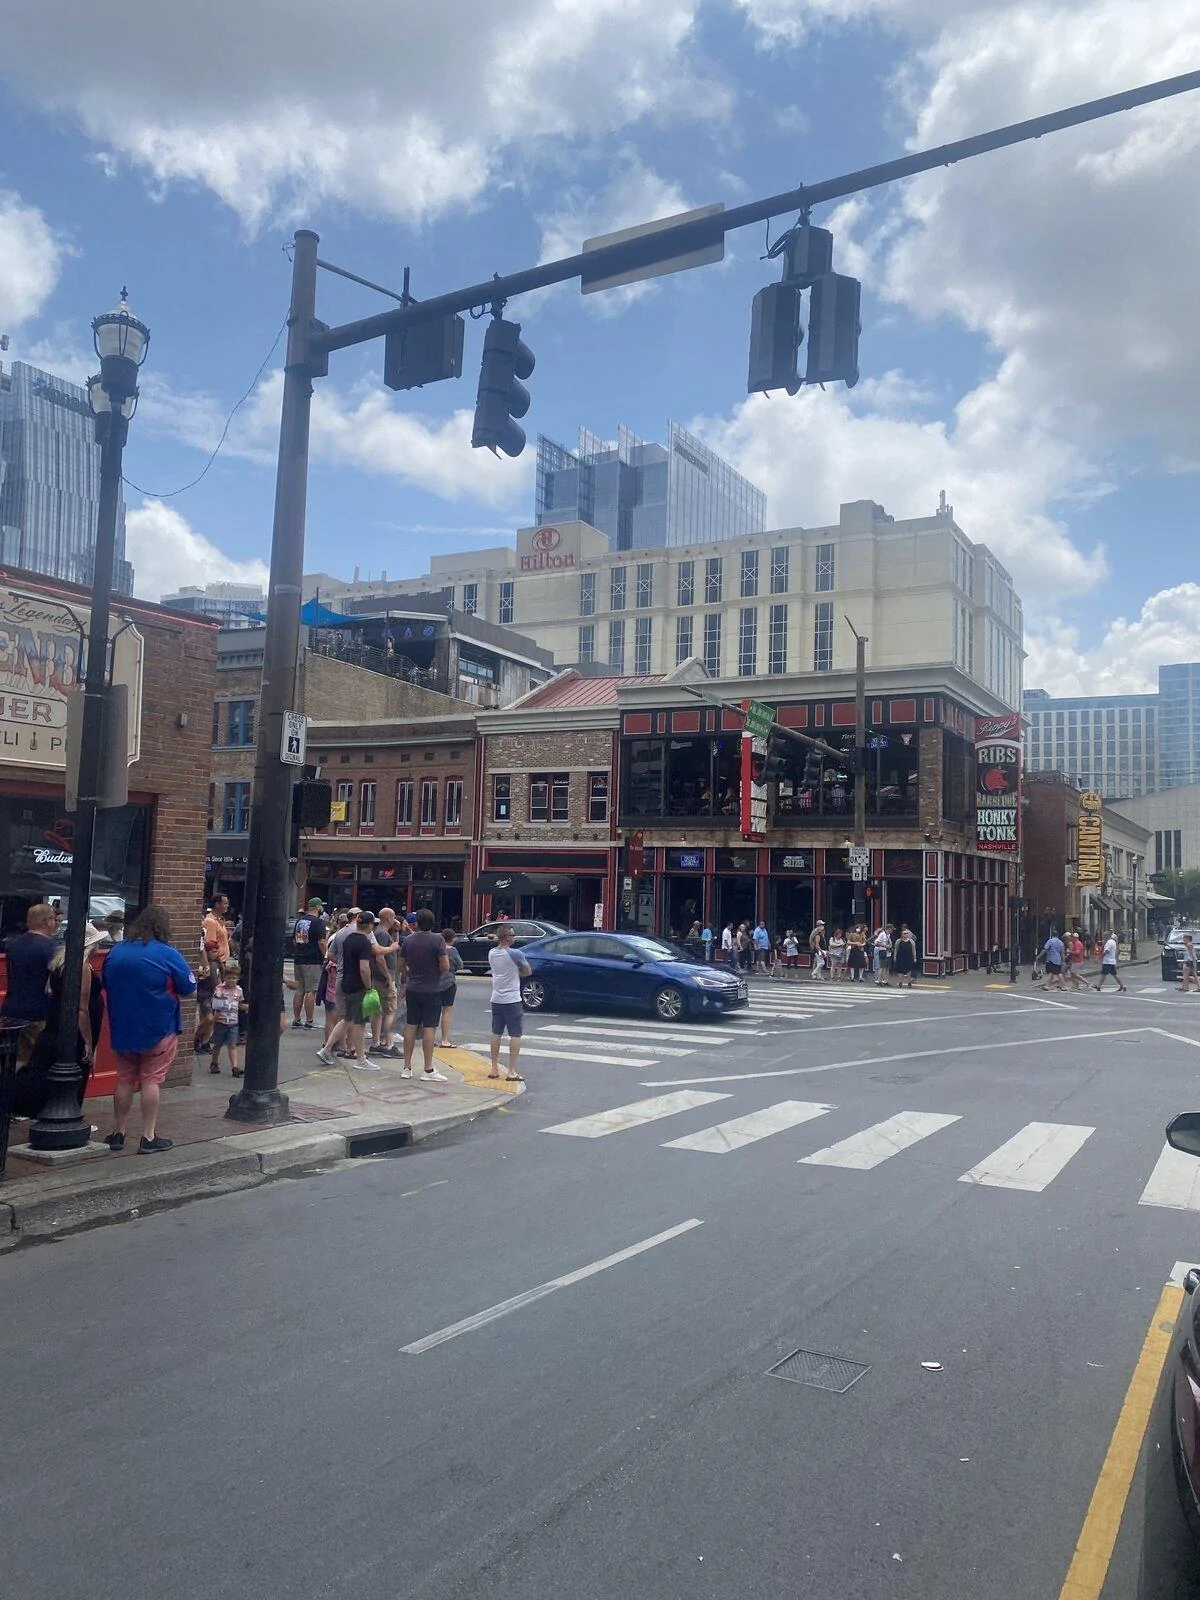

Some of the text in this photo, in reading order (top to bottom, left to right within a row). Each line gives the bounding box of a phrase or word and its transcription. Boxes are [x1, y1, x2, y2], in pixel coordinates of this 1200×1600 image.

[519, 552, 576, 571] Hilton
[287, 713, 304, 723] CROSS
[288, 720, 302, 730] ONLY
[976, 714, 1017, 735] Rippy's
[978, 746, 1017, 764] RIBS
[977, 809, 1017, 825] HONKY
[977, 825, 1017, 841] TONK
[978, 843, 1016, 851] NASHVILLE
[1078, 816, 1101, 880] CANTINA
